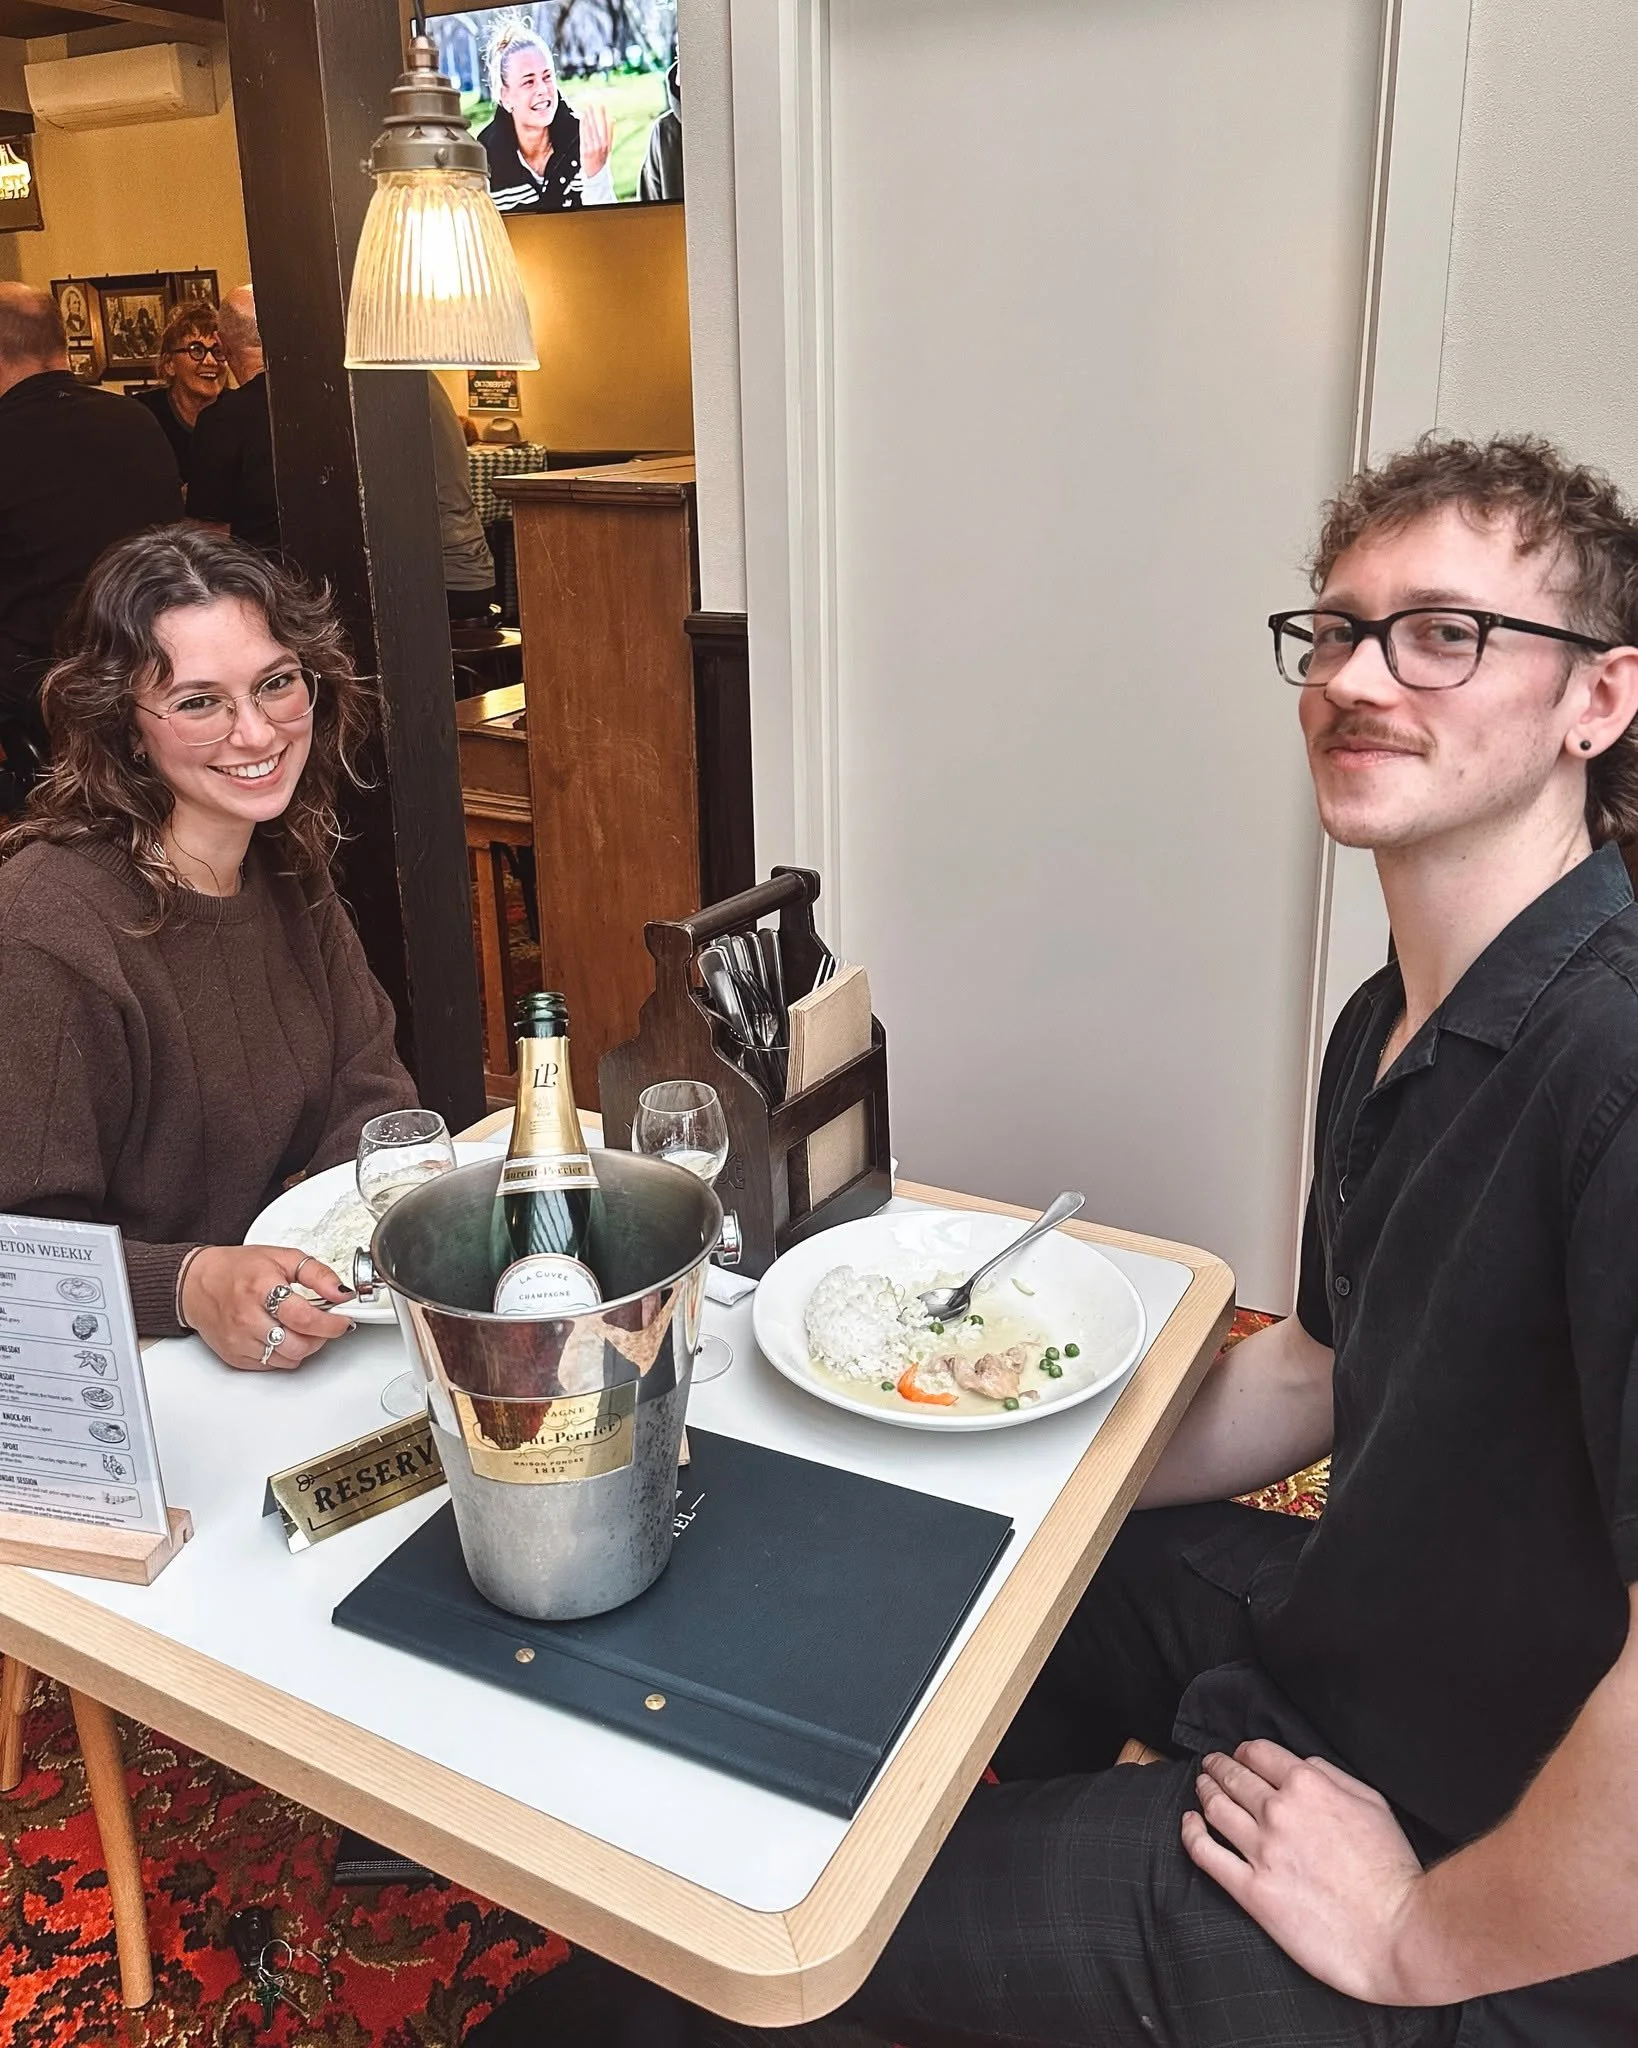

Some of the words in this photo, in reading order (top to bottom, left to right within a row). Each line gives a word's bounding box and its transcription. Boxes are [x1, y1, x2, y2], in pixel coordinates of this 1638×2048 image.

[0, 175, 30, 199] ETS
[38, 1244, 93, 1261] WEEKLY
[519, 1290, 571, 1301] CHAMPAGNE
[2, 1411, 32, 1423] KNOCK-OFF
[313, 1434, 434, 1513] RESERV
[534, 1466, 566, 1475] 1812
[16, 1476, 38, 1486] SESSION
